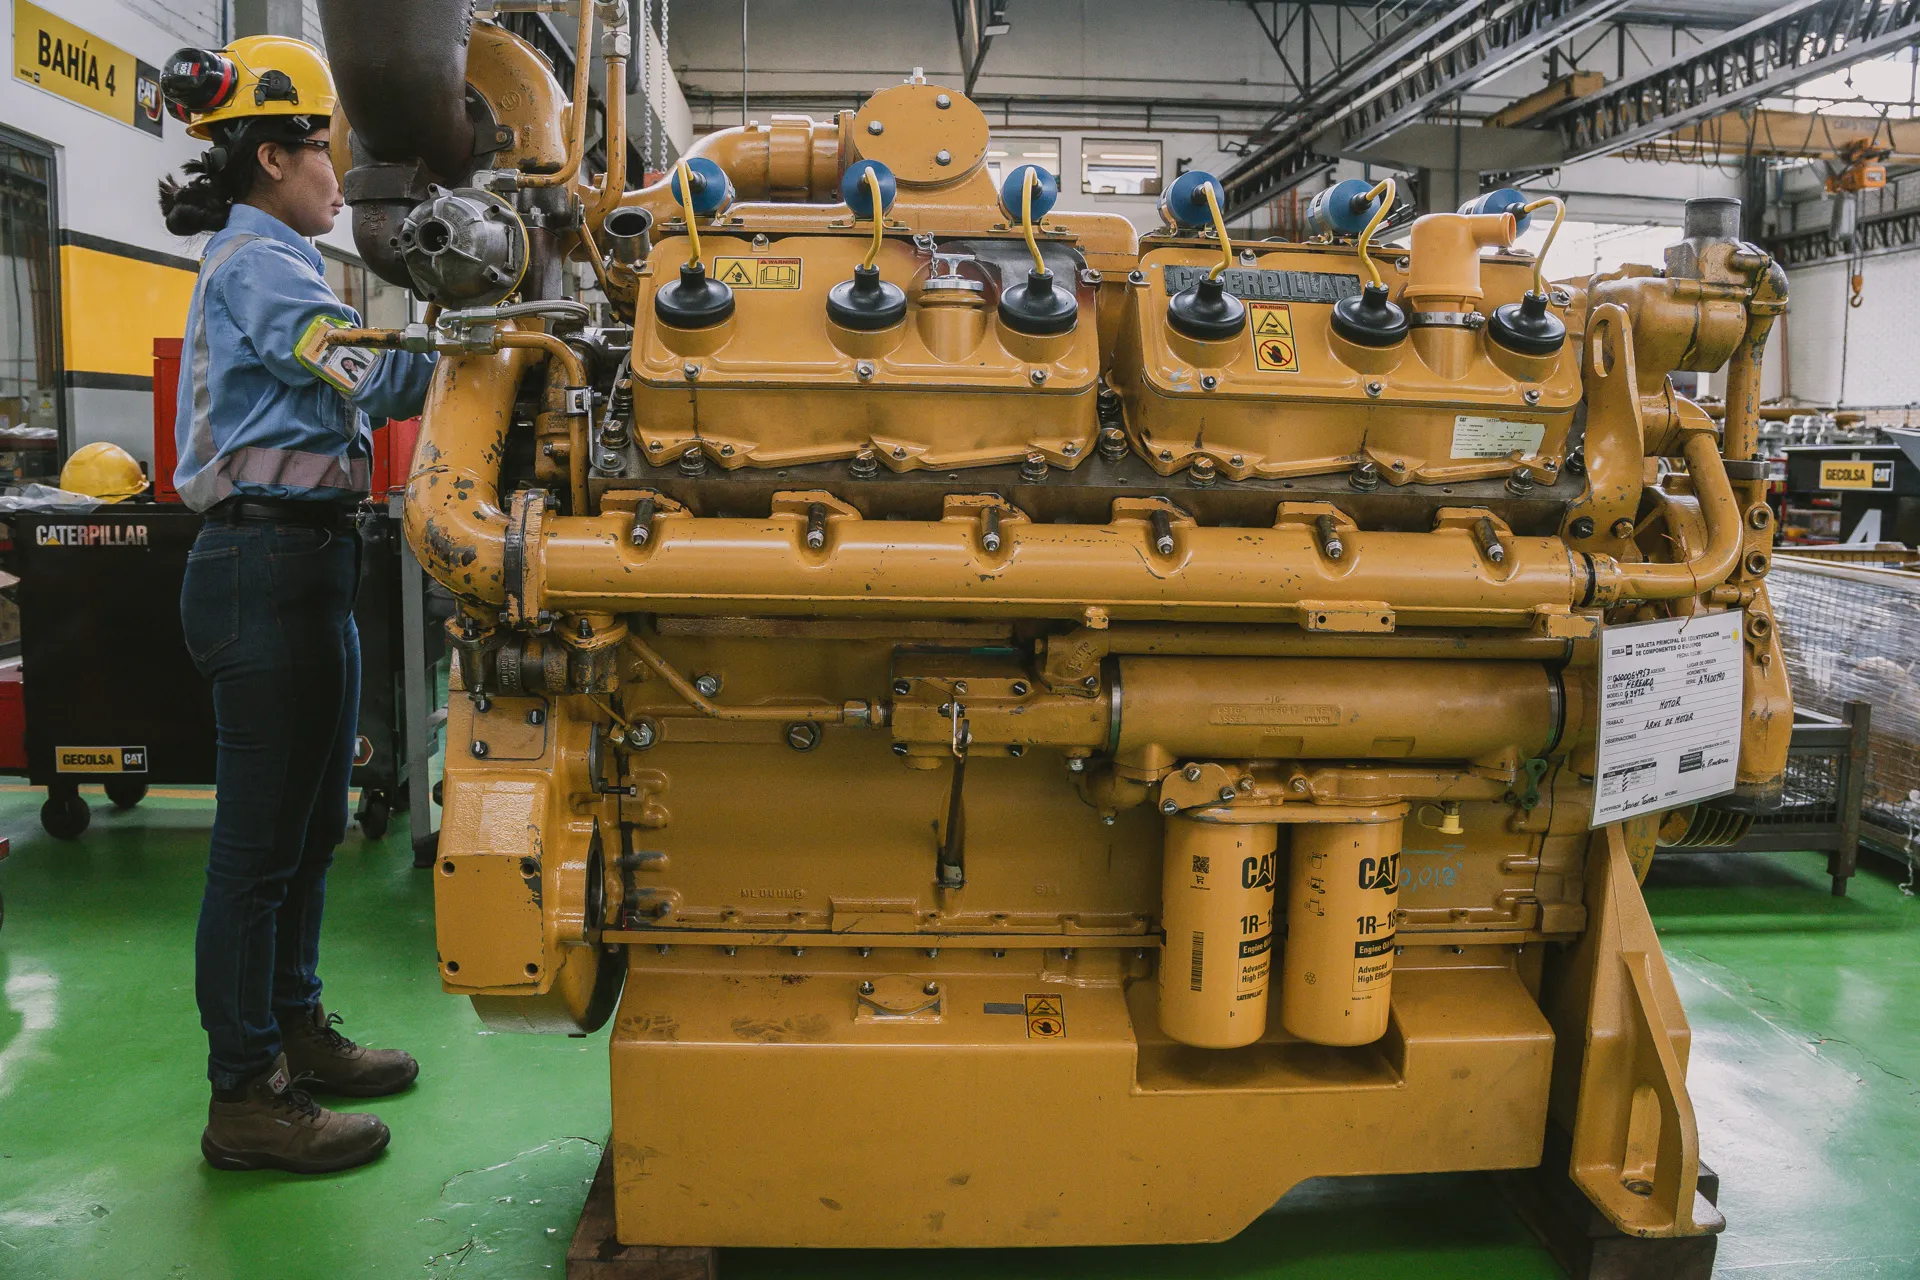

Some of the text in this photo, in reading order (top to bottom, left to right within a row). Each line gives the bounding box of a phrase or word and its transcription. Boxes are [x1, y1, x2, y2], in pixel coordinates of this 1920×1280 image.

[38, 28, 116, 97] BAHÍA 4
[137, 76, 158, 109] CAT
[1173, 267, 1353, 301] CERPILLAR
[1825, 468, 1891, 482] GECOLSA CAT
[36, 525, 148, 546] CATERPILLAR
[1635, 641, 1656, 649] TARJETA
[1656, 637, 1680, 645] PRINCIPAL
[1642, 645, 1677, 656] COMPONENTES
[1606, 682, 1623, 690] CLIENTE
[1606, 691, 1624, 699] MODELO
[1605, 699, 1633, 709] COMPONENTE
[1658, 696, 1681, 710] MOTOR
[1605, 718, 1625, 726] TRABAJO
[1674, 712, 1694, 724] MOTOR
[1604, 733, 1637, 745] OBSERVACIONES
[62, 752, 143, 766] GECOLSA CAT
[1241, 850, 1276, 893] CAT
[1358, 851, 1400, 895] CAT
[1243, 943, 1264, 954] Engine
[1359, 944, 1382, 954] Engine
[1242, 960, 1268, 974] Advanced
[1358, 960, 1388, 974] Advanced
[1241, 972, 1257, 984] High
[1357, 974, 1374, 984] High
[1236, 989, 1263, 1001] CATERPILLAR
